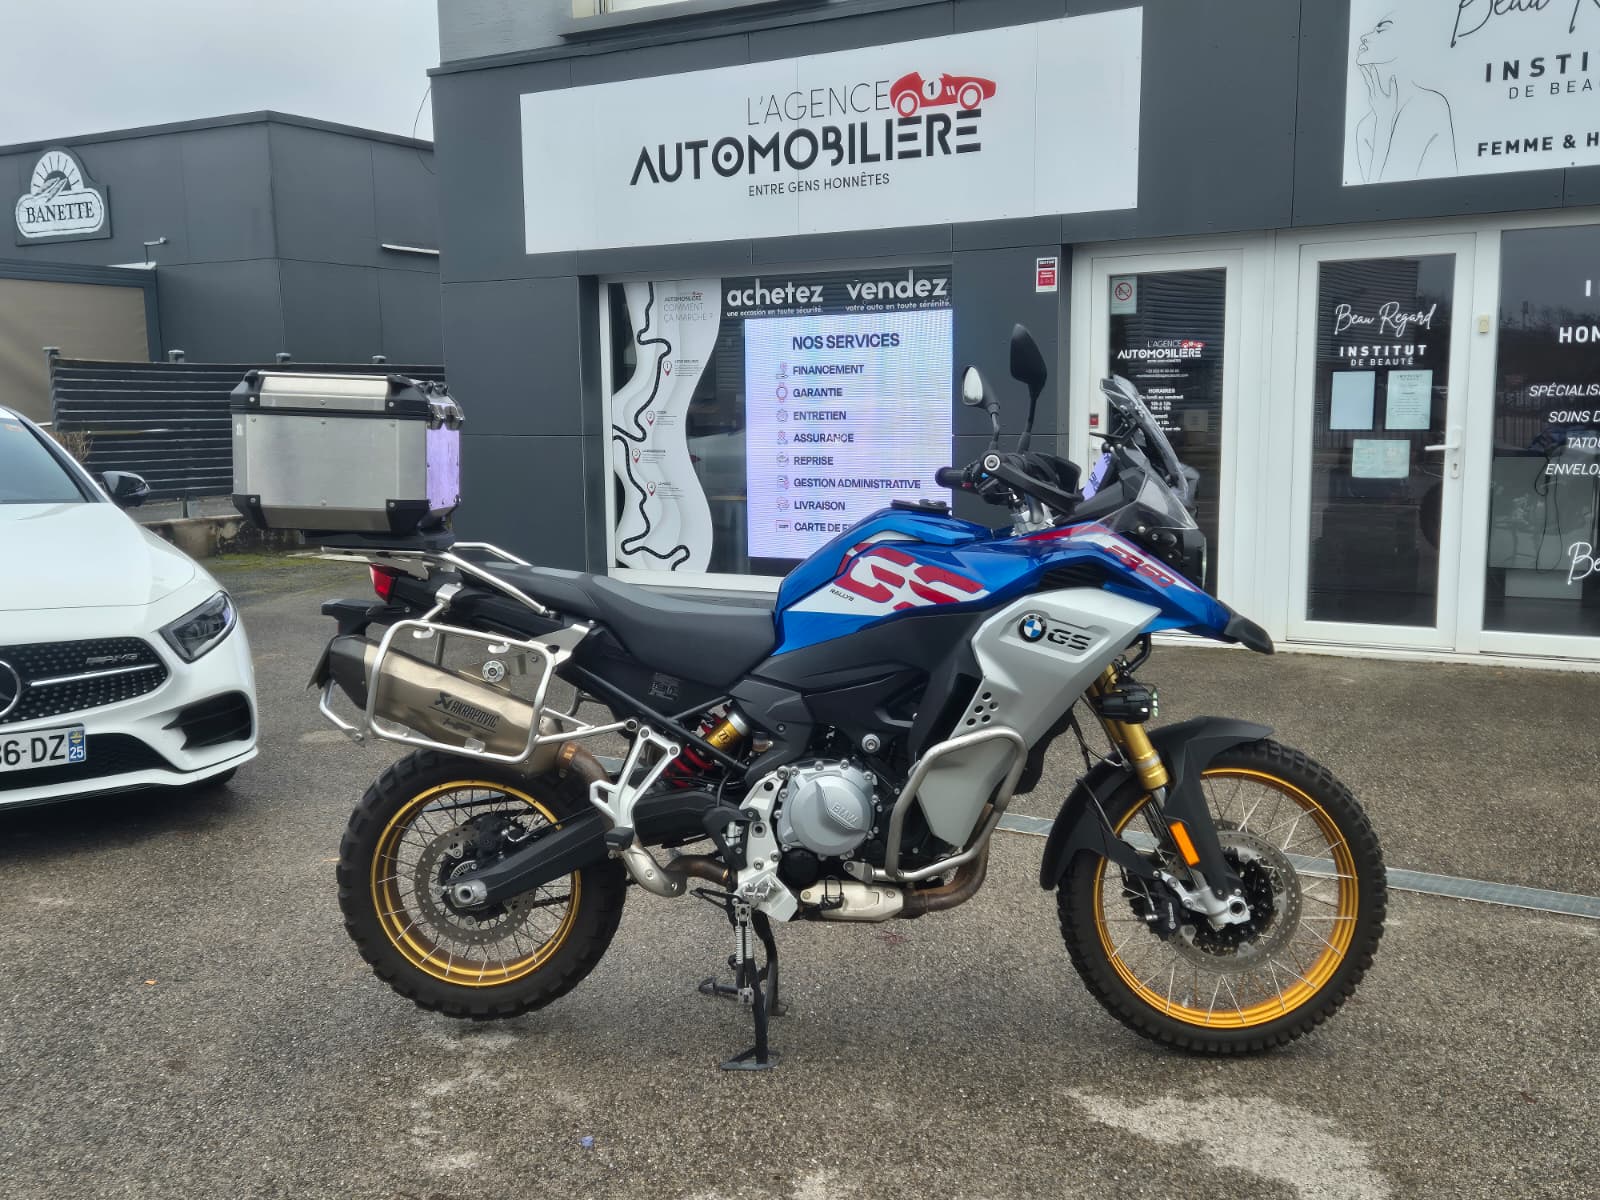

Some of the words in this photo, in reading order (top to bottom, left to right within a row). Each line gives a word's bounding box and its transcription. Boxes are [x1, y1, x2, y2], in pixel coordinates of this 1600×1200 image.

[927, 81, 936, 96] 1
[1508, 85, 1535, 100] DE
[1549, 78, 1600, 95] BEA
[747, 79, 890, 126] L'AGENCE
[1476, 136, 1554, 157] FEMME
[1562, 133, 1577, 150] &
[748, 182, 785, 197] ENTRE
[787, 179, 820, 194] GENS
[824, 171, 890, 191] HONNÊTES
[25, 201, 95, 224] BANETTE
[845, 269, 948, 300] vendez
[726, 278, 824, 307] achetez
[740, 308, 766, 317] occasion
[777, 307, 795, 315] toute
[845, 303, 865, 311] votre
[866, 302, 884, 310] auto
[1334, 303, 1375, 336] Beau
[1379, 301, 1437, 338] Regard
[792, 335, 824, 351] NOS
[826, 332, 900, 349] SERVICES
[1339, 344, 1427, 357] INSTITUT
[1350, 359, 1364, 367] DE
[1370, 356, 1414, 367] BEAUTÉ
[793, 364, 865, 375] FINANCEMENT
[793, 387, 843, 397] GARANTIE
[1528, 381, 1600, 397] SPÉCIALIS
[793, 411, 847, 421] ENTRETIEN
[1547, 410, 1591, 423] SOINS
[793, 433, 855, 443] ASSURANCE
[793, 456, 834, 466] REPRISE
[1544, 463, 1600, 478] ENVELO
[793, 478, 836, 488] GESTION
[837, 479, 921, 489] ADMINISTRATIVE
[793, 501, 846, 511] LIVRAISON
[794, 523, 826, 533] CARTE
[827, 523, 841, 533] DE
[1046, 628, 1092, 651] GS
[0, 734, 66, 766] 6-DZ
[69, 745, 84, 760] 25
